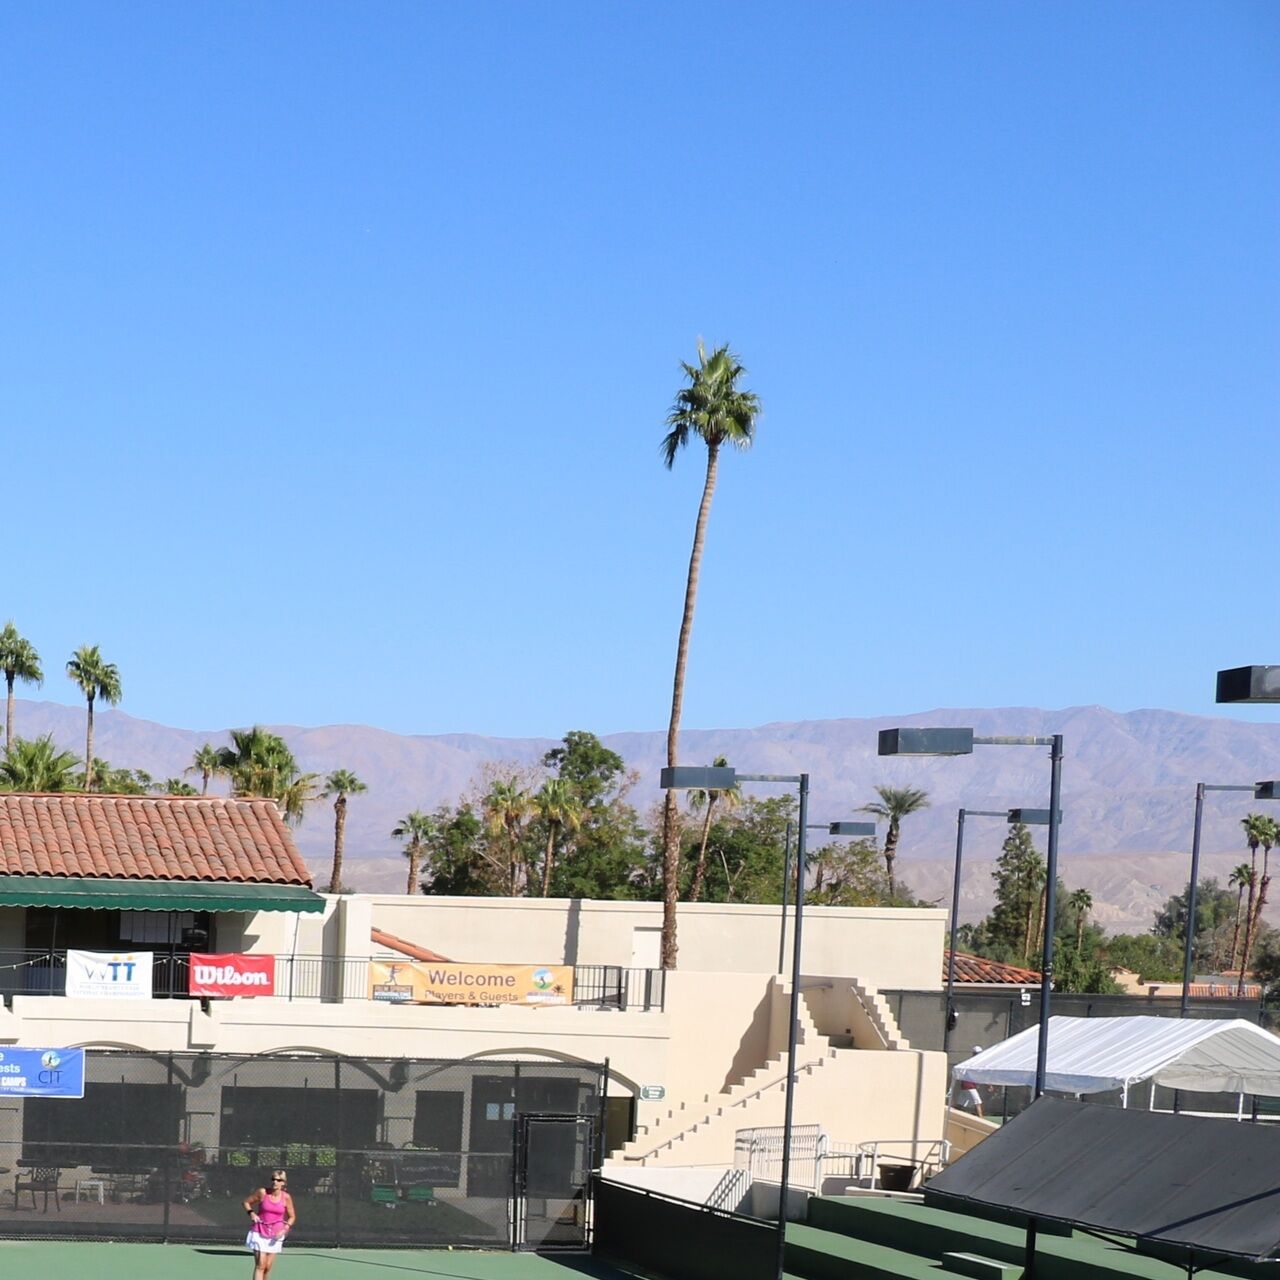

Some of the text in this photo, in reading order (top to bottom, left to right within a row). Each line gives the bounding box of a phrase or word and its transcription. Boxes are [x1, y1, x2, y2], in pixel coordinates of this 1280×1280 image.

[193, 965, 271, 985] Wilson
[429, 970, 516, 987] Welcome
[425, 989, 465, 1001] Players
[469, 991, 477, 1000] &
[480, 992, 518, 1002] Guests
[1, 1077, 27, 1087] CAMPS
[38, 1070, 63, 1084] CIT
